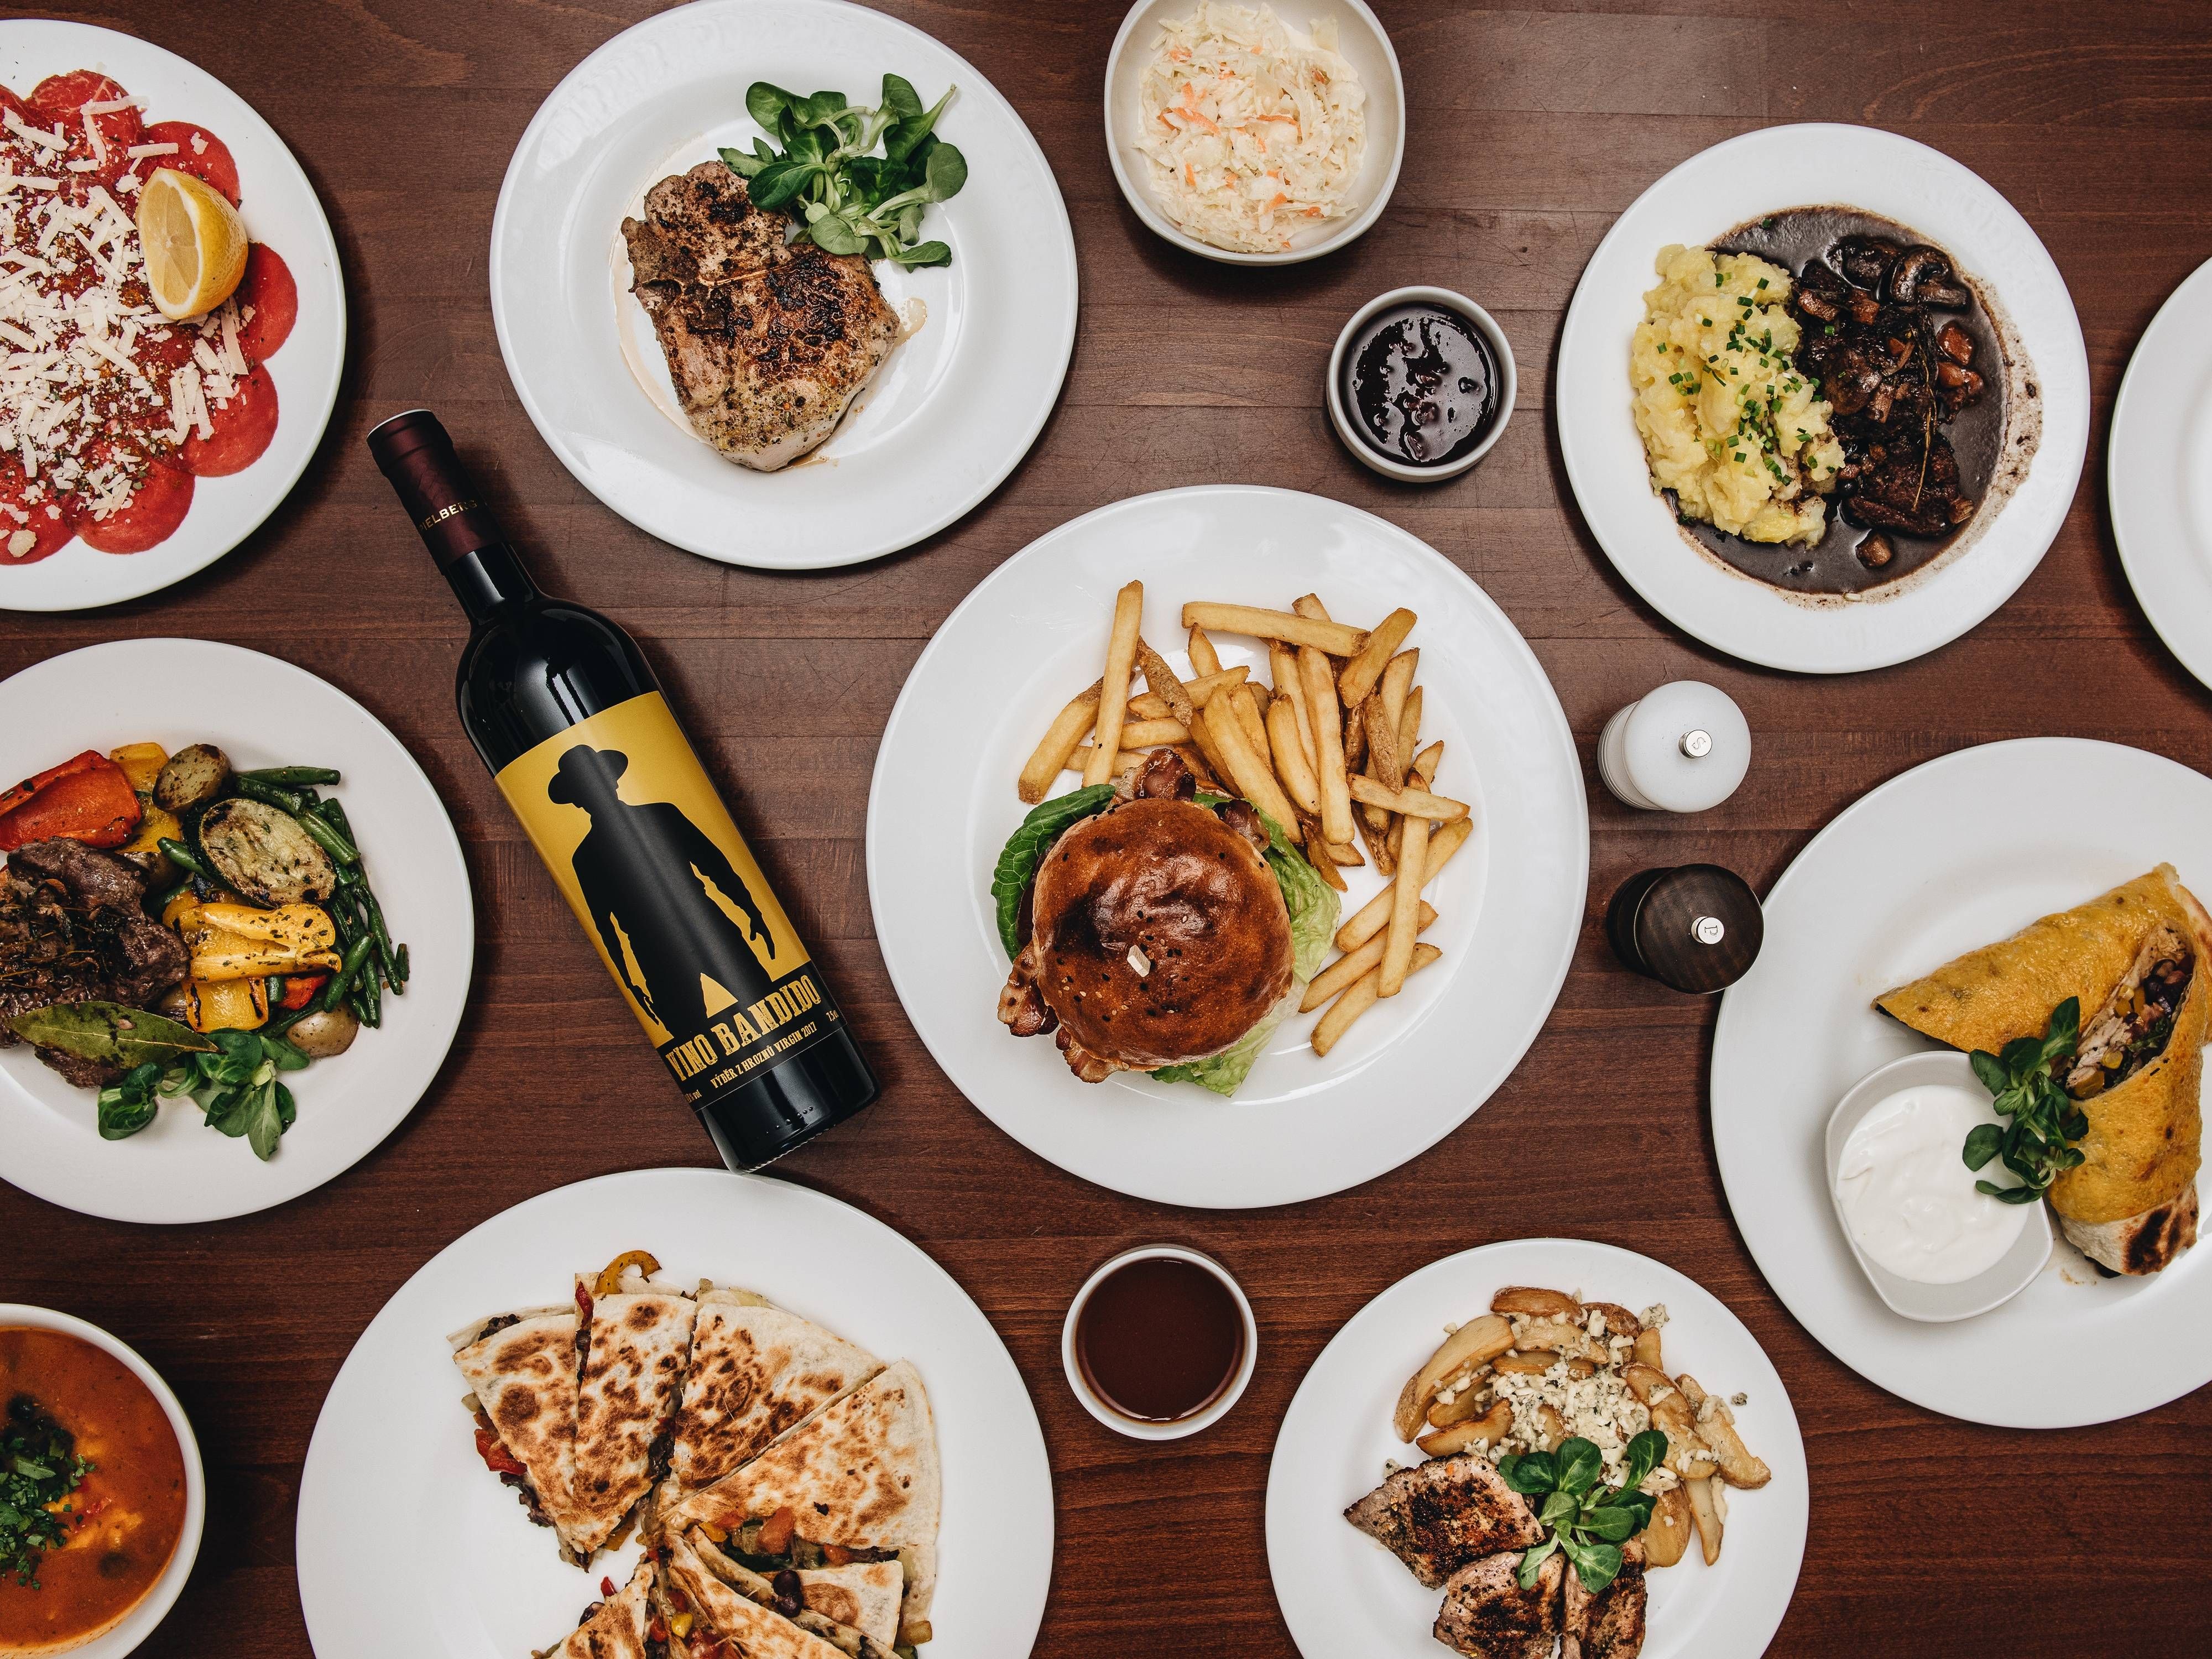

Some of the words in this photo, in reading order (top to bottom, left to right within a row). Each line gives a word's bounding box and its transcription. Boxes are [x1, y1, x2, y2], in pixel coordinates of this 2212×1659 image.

[1691, 736, 1707, 749] S
[665, 1034, 718, 1082] VINO
[710, 974, 822, 1056] BANDIDO
[710, 1068, 738, 1088] VÝBĚR
[735, 1065, 744, 1075] Z
[742, 1045, 775, 1072] HROZNŮ
[773, 1030, 804, 1053] VIRGIN
[801, 1021, 817, 1038] 2017
